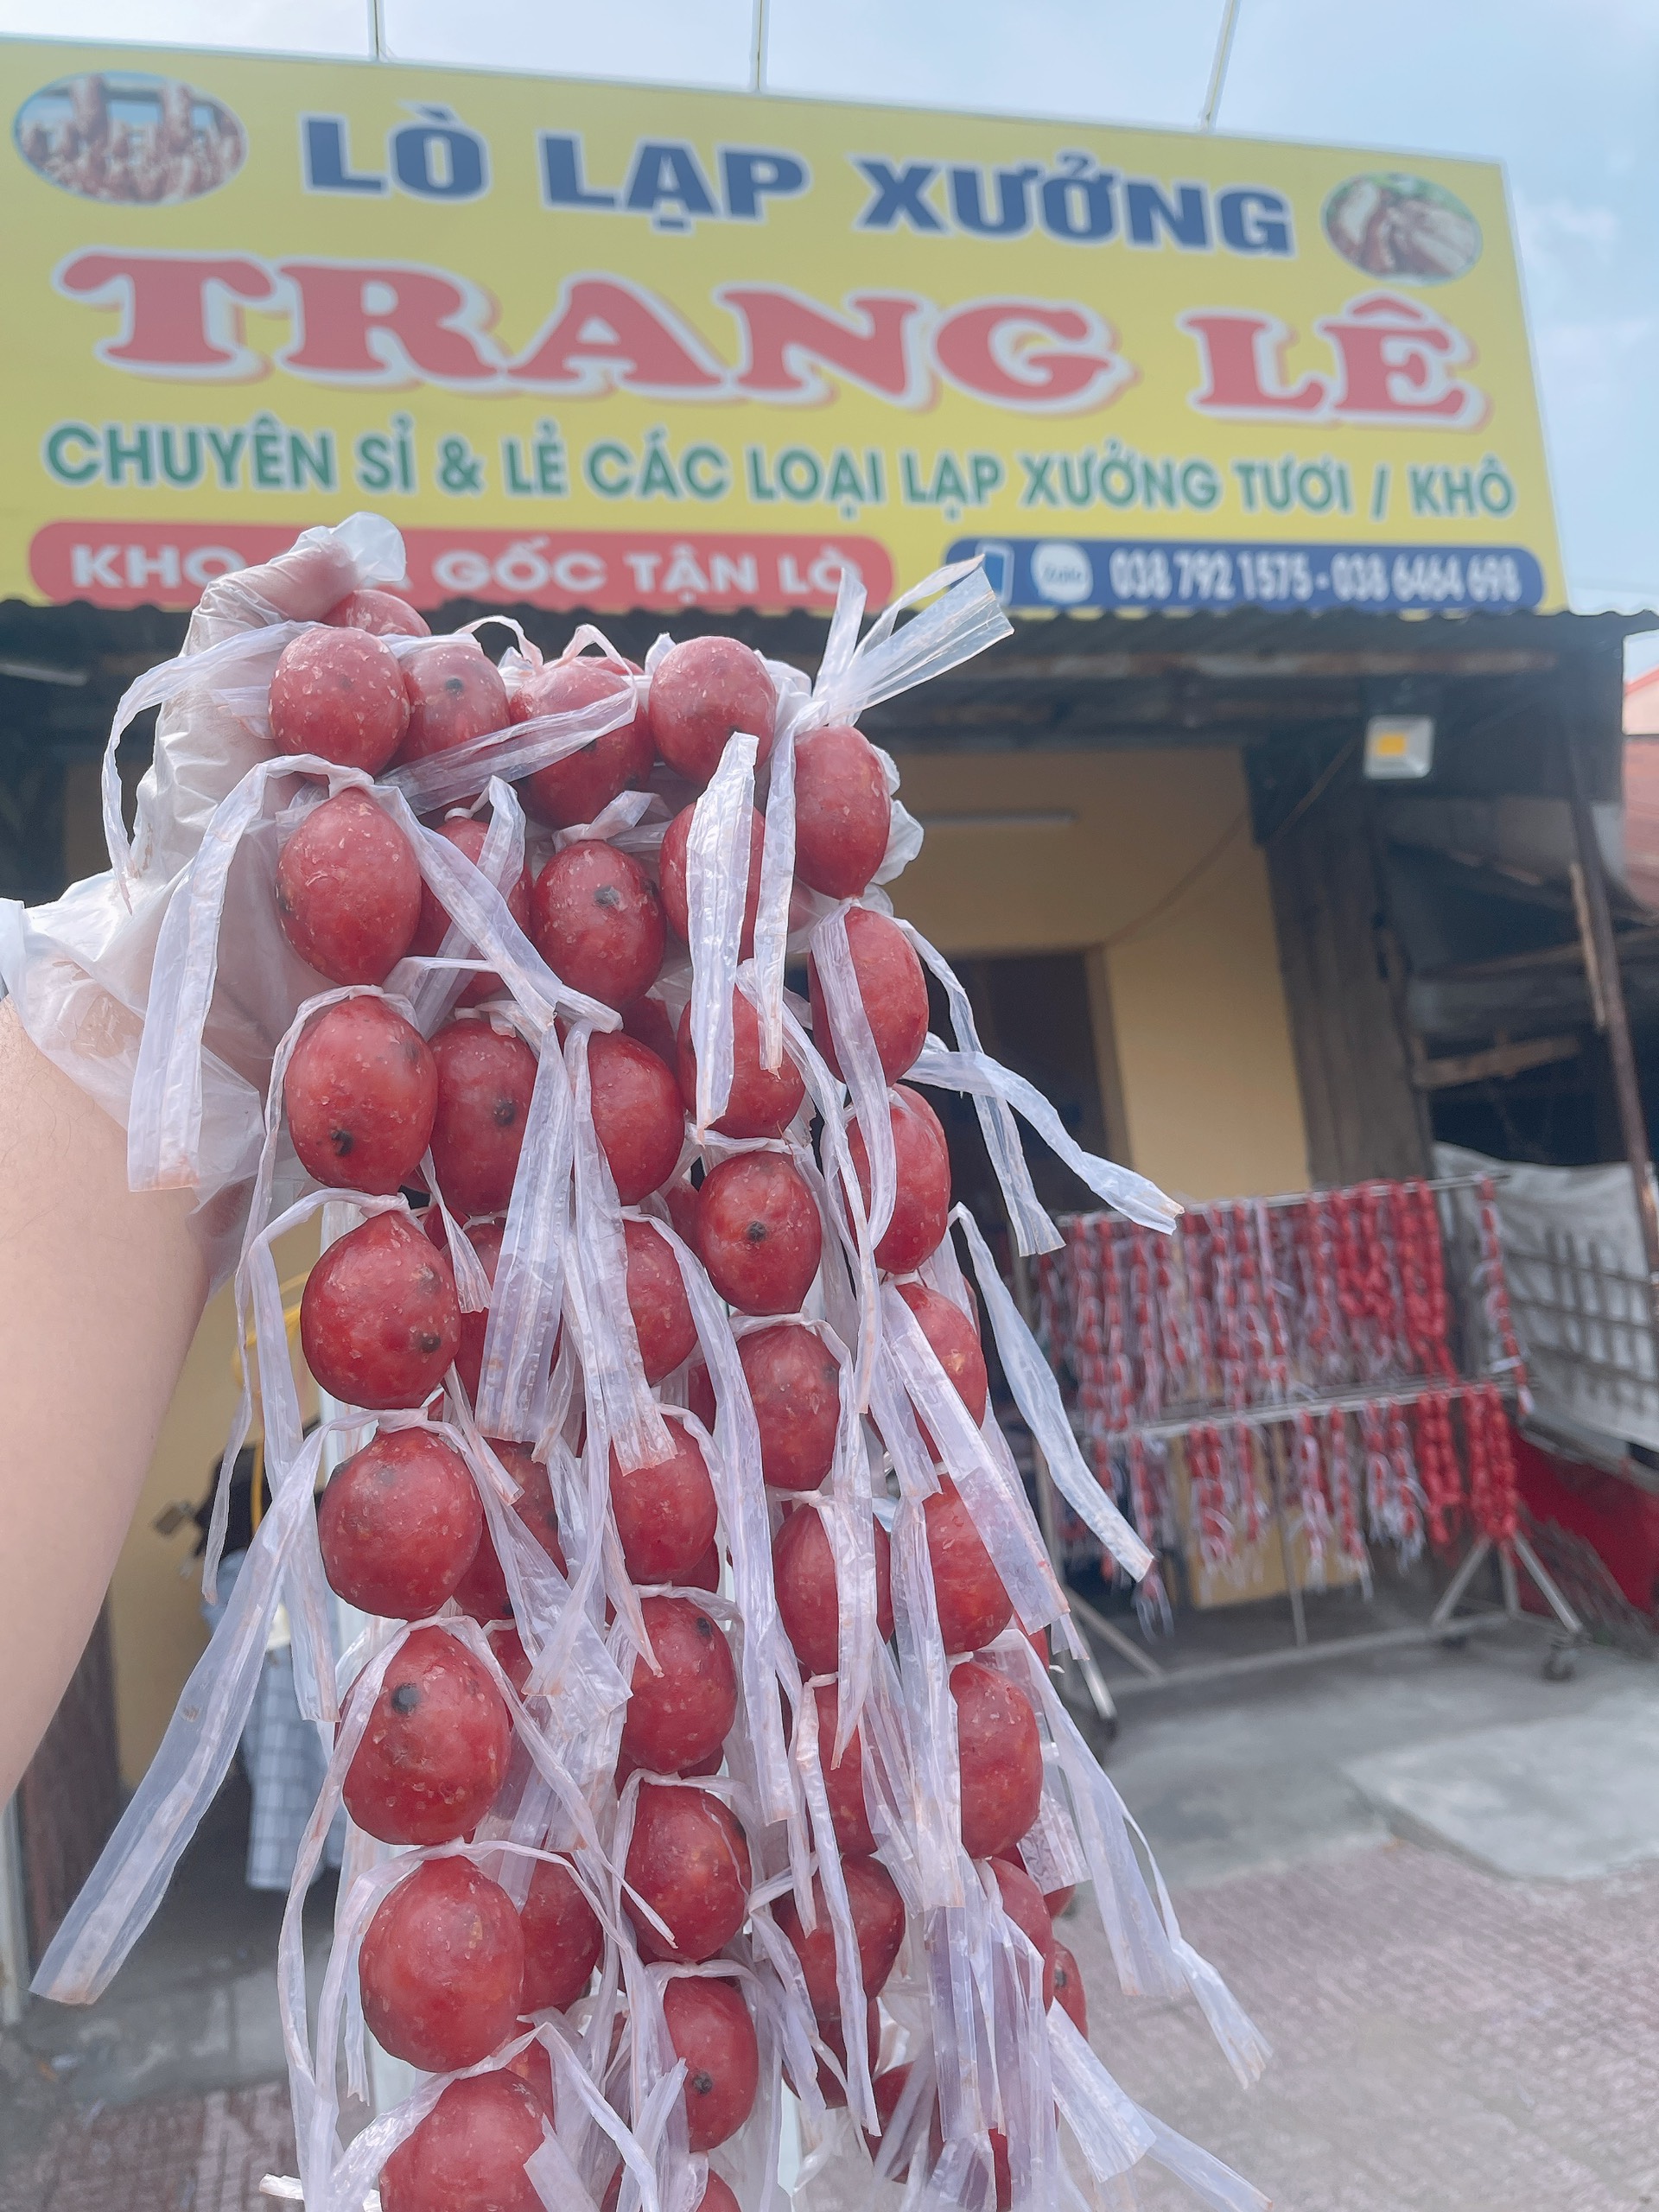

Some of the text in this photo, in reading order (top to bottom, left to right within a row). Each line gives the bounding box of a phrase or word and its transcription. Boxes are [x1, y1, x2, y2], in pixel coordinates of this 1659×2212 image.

[301, 102, 1296, 259] LÒ LẠP XƯỞNG
[52, 247, 1490, 432] TRANG LÊ
[45, 411, 1516, 522] CHUYÊN SỈ & LẺ CÁC LOẠI LẠP XƯỞNG TƯƠI / KHÔ
[432, 533, 607, 593] GỐC
[624, 543, 760, 607] TẬN
[778, 544, 864, 596] LÒ
